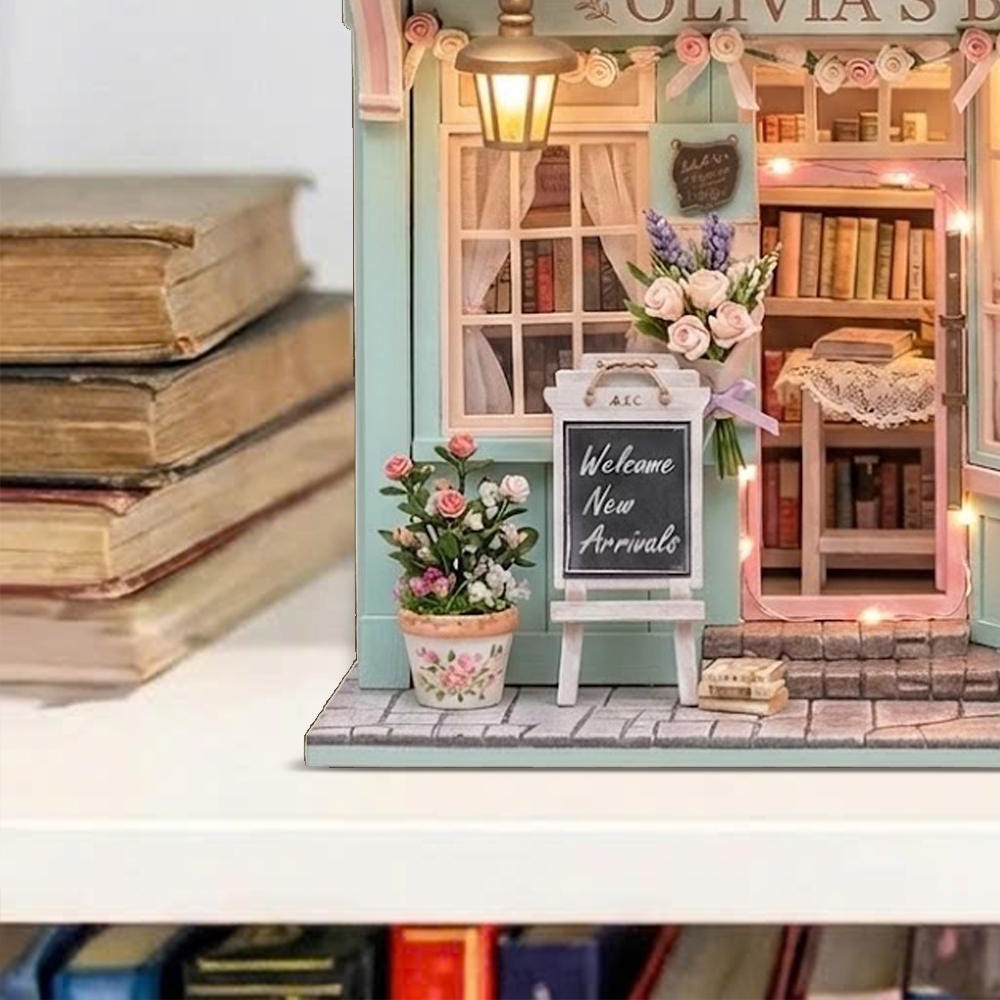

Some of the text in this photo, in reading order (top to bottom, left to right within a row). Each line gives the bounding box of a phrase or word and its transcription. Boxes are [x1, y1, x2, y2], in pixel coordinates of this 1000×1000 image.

[579, 443, 675, 476] Welcome
[582, 484, 636, 516] New
[579, 523, 681, 554] Arrivals
